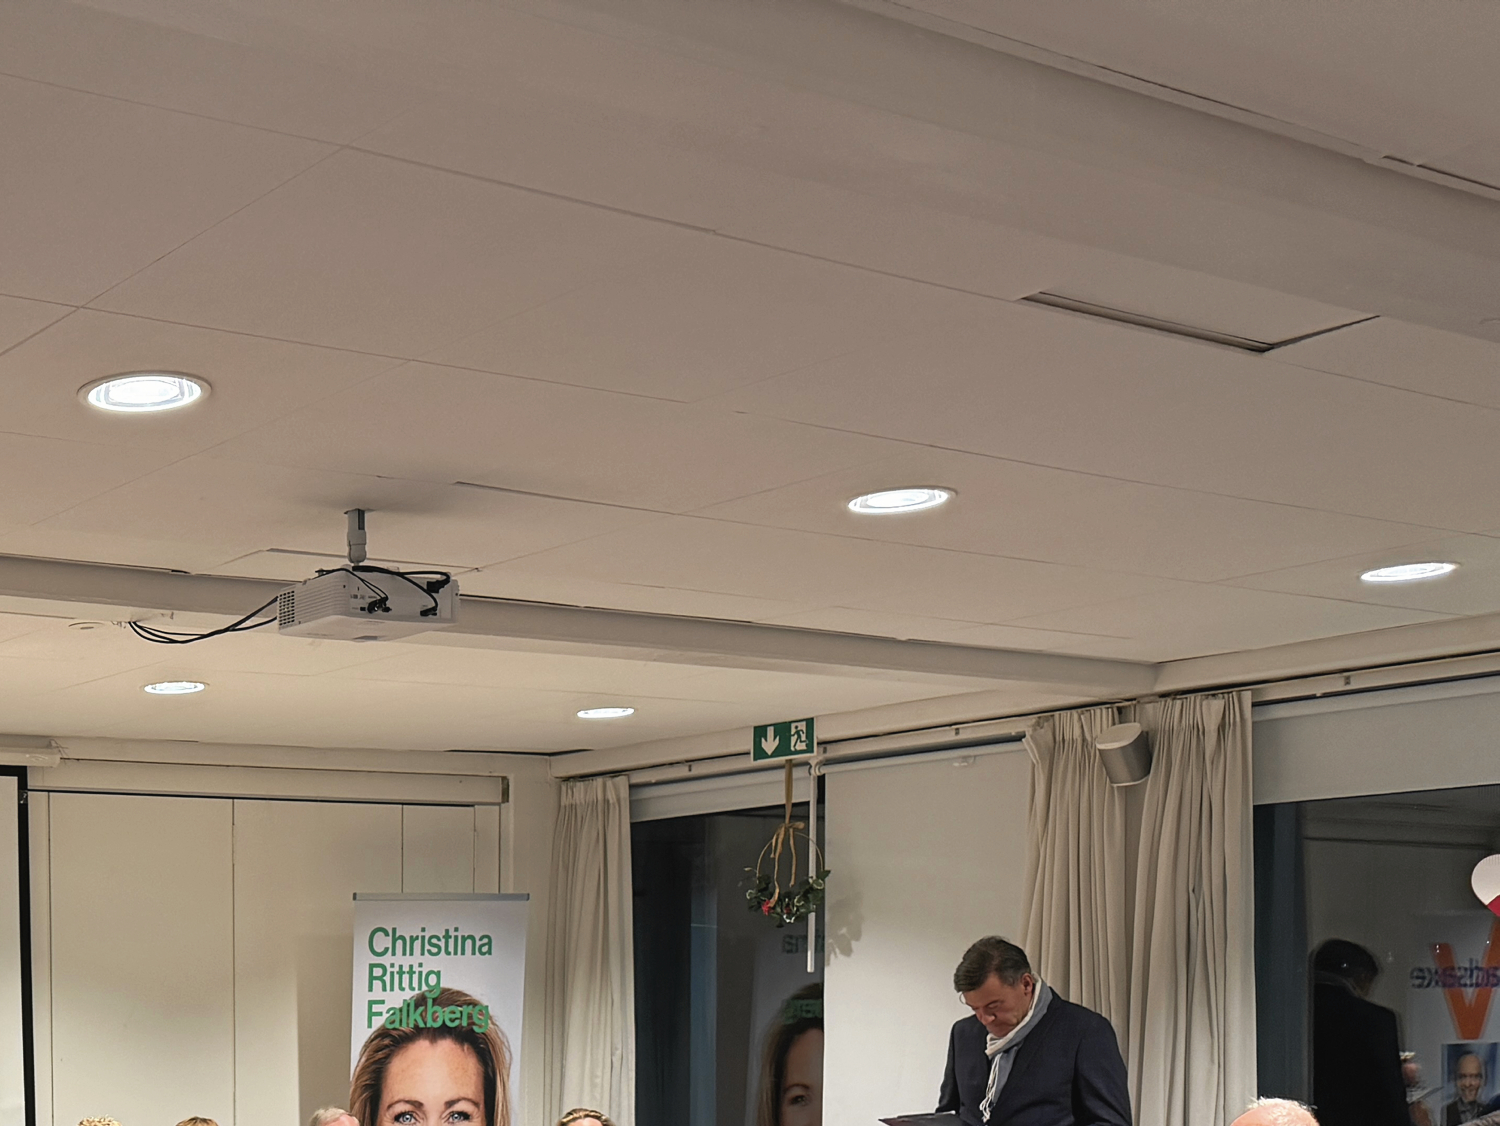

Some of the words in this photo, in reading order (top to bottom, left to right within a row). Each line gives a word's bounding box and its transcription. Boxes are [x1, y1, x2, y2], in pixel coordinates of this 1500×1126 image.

[367, 926, 493, 957] Christina
[367, 962, 442, 998] Rittig
[366, 998, 490, 1034] Falkberg
